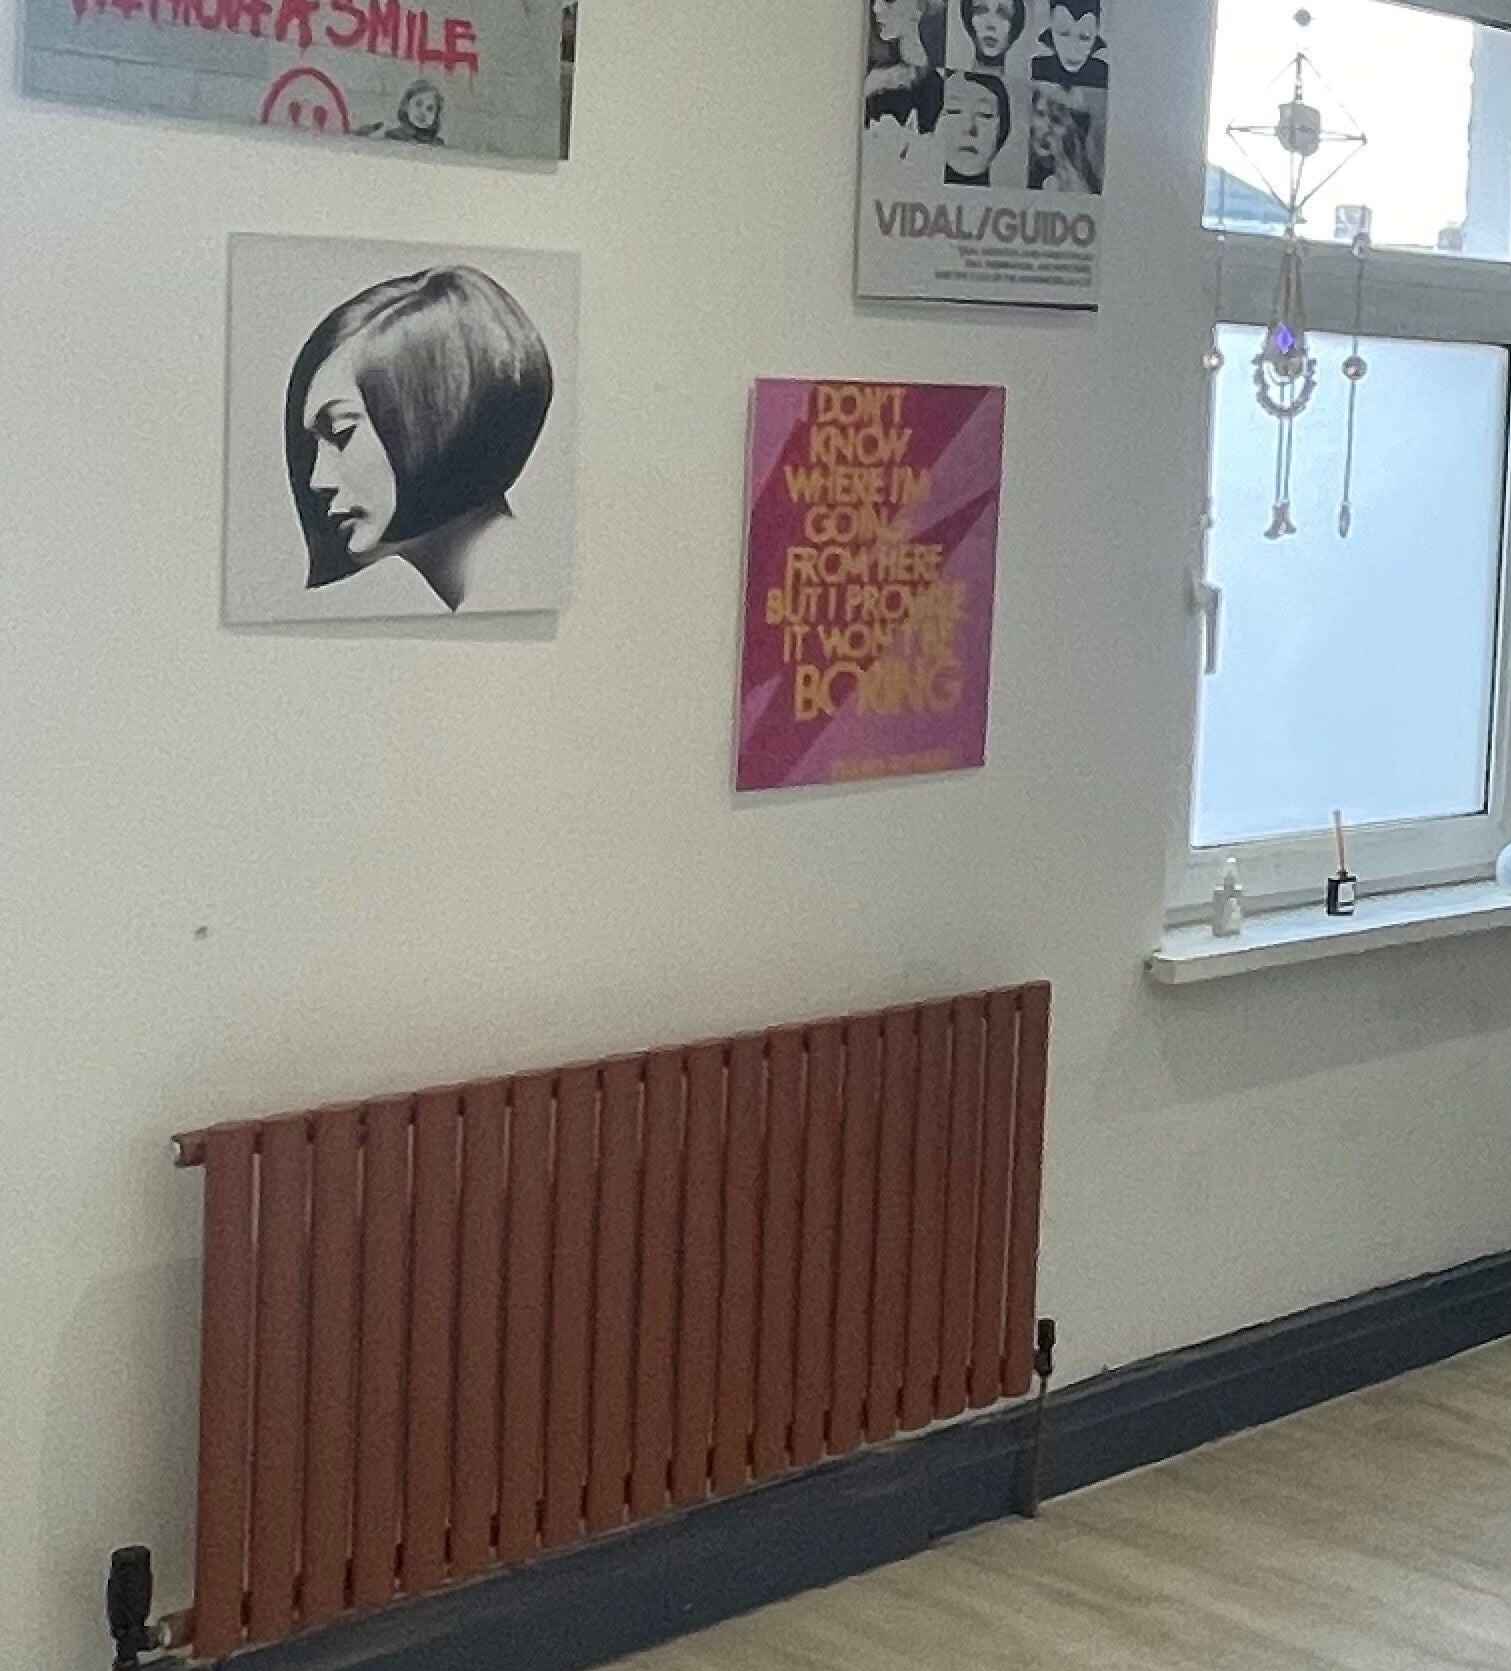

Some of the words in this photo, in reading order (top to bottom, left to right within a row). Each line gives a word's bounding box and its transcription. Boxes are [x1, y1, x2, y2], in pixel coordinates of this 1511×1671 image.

[275, 0, 319, 48] A
[325, 0, 479, 73] SMILE
[874, 199, 1097, 247] VIDAL/GUIDO
[816, 384, 908, 425] DON'T
[809, 424, 913, 467] KNOW
[783, 464, 886, 505] WHERE
[784, 545, 870, 585] FROM
[873, 542, 945, 583] HERE
[764, 582, 822, 626] BUT
[827, 586, 838, 622] I
[783, 624, 811, 664] IT
[794, 658, 964, 722] BORING
